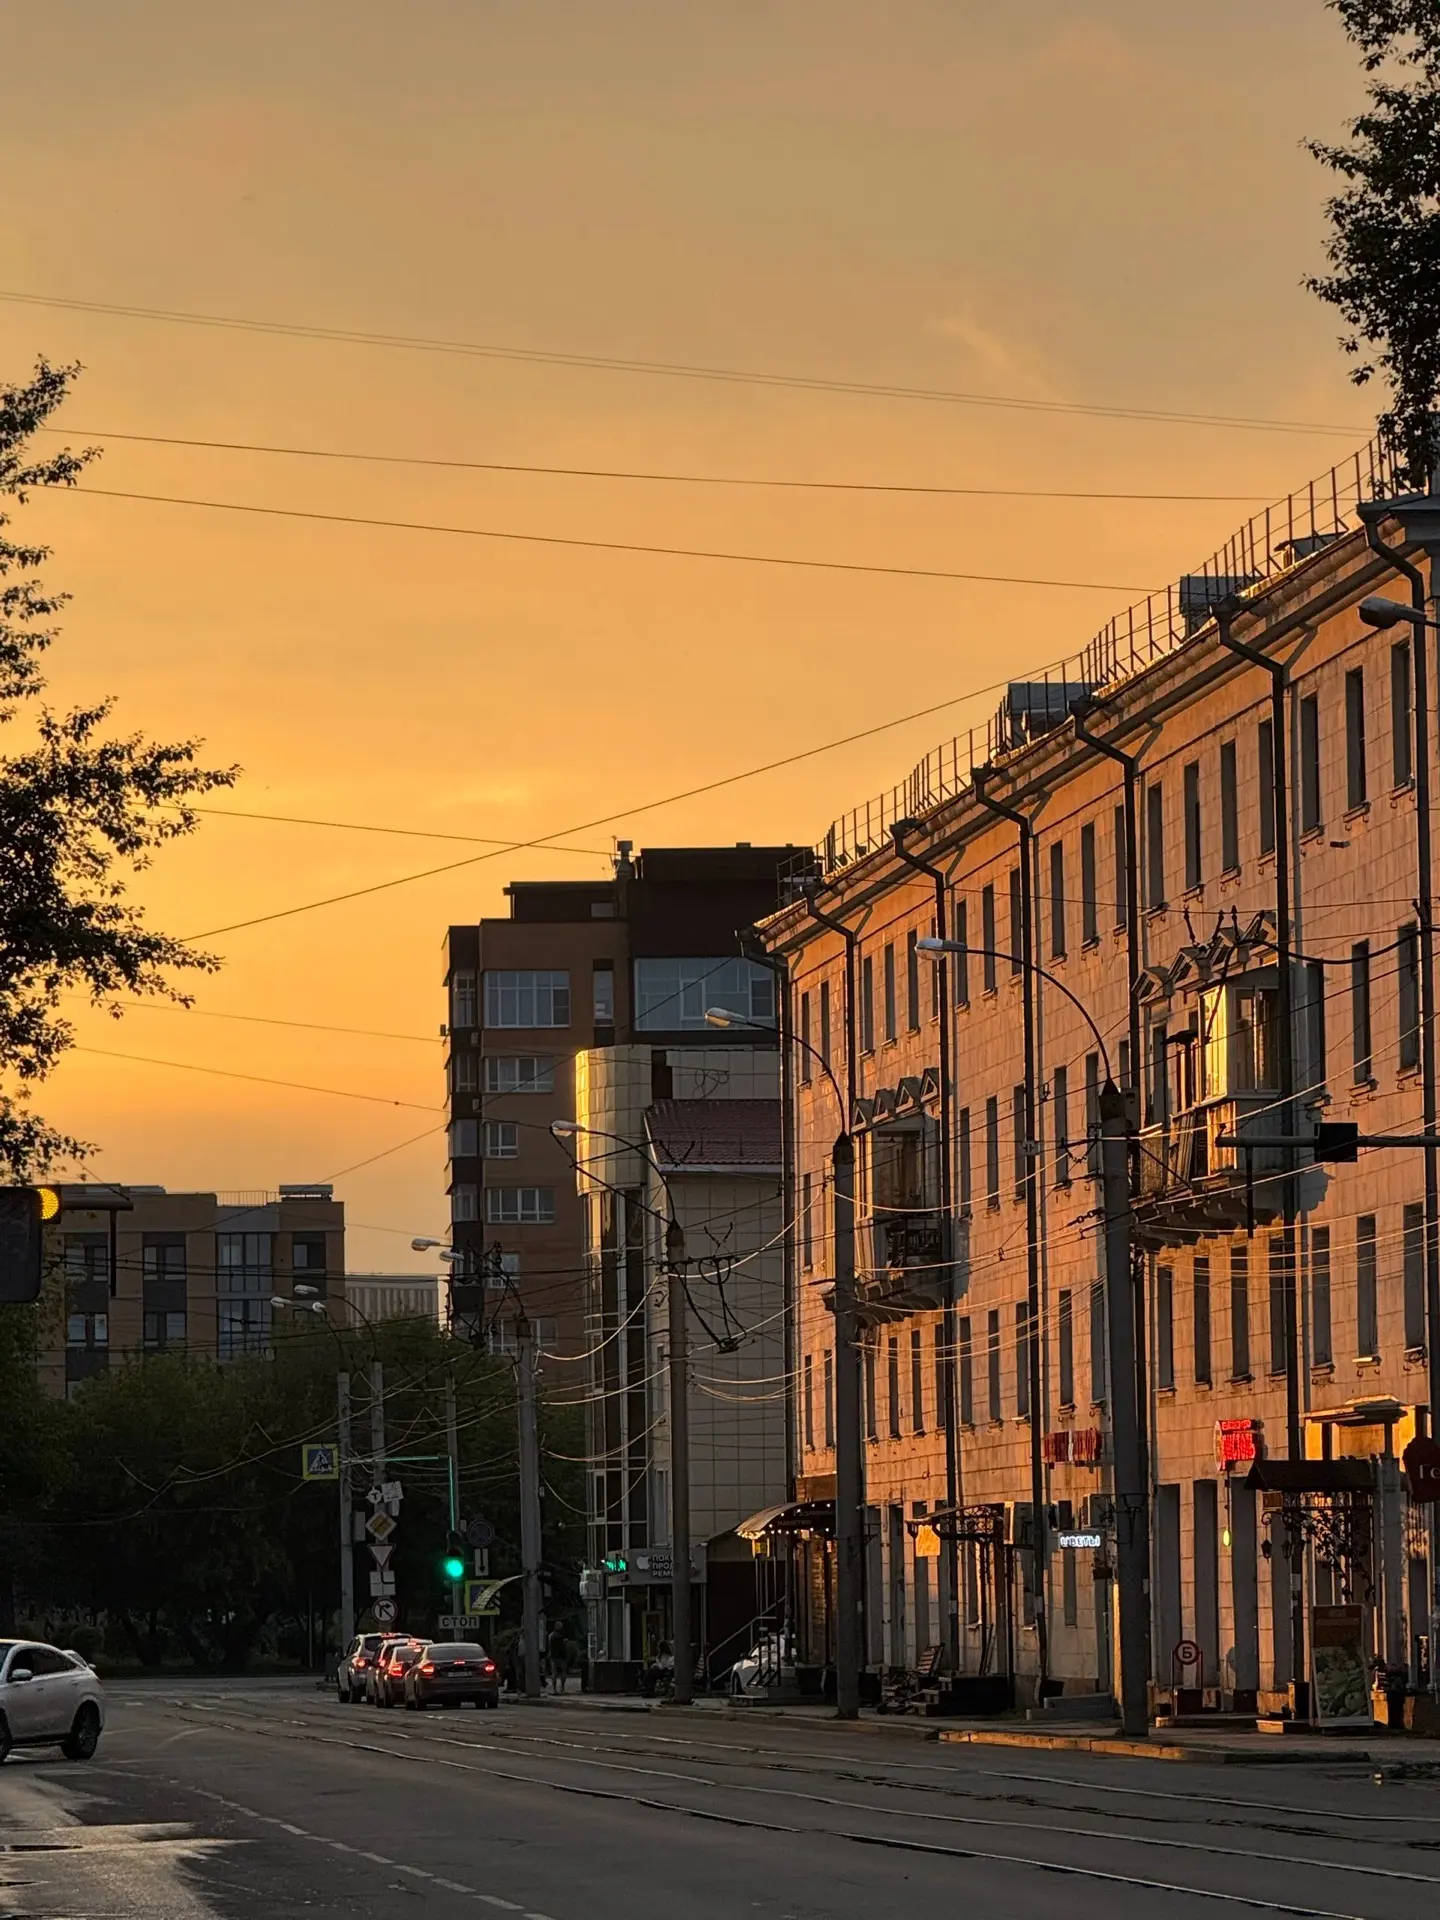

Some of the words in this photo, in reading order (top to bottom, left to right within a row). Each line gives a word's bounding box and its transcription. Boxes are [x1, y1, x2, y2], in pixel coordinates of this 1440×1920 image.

[1060, 1534, 1100, 1547] ЦВЕТЫ
[442, 1617, 477, 1627] СТОП
[1182, 1645, 1193, 1658] Б
